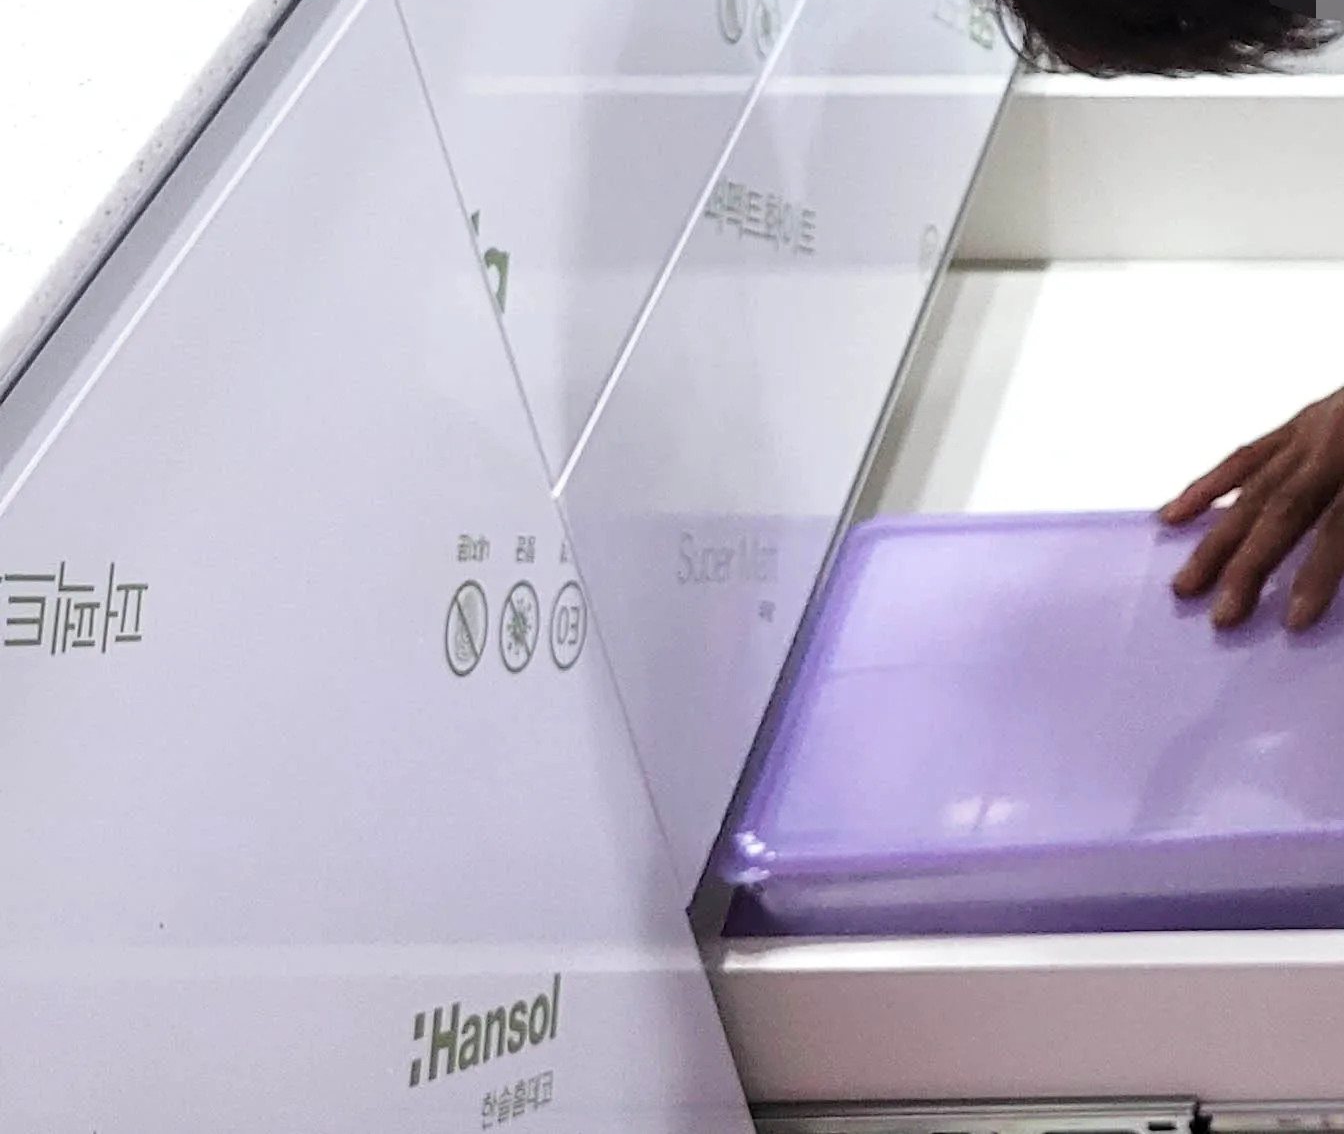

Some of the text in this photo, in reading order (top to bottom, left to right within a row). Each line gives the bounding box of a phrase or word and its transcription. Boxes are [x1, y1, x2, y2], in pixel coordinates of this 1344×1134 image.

[0, 560, 149, 658] 퍼펙트
[427, 971, 563, 1083] Hansol
[481, 1069, 555, 1131] 한솔홈데코
